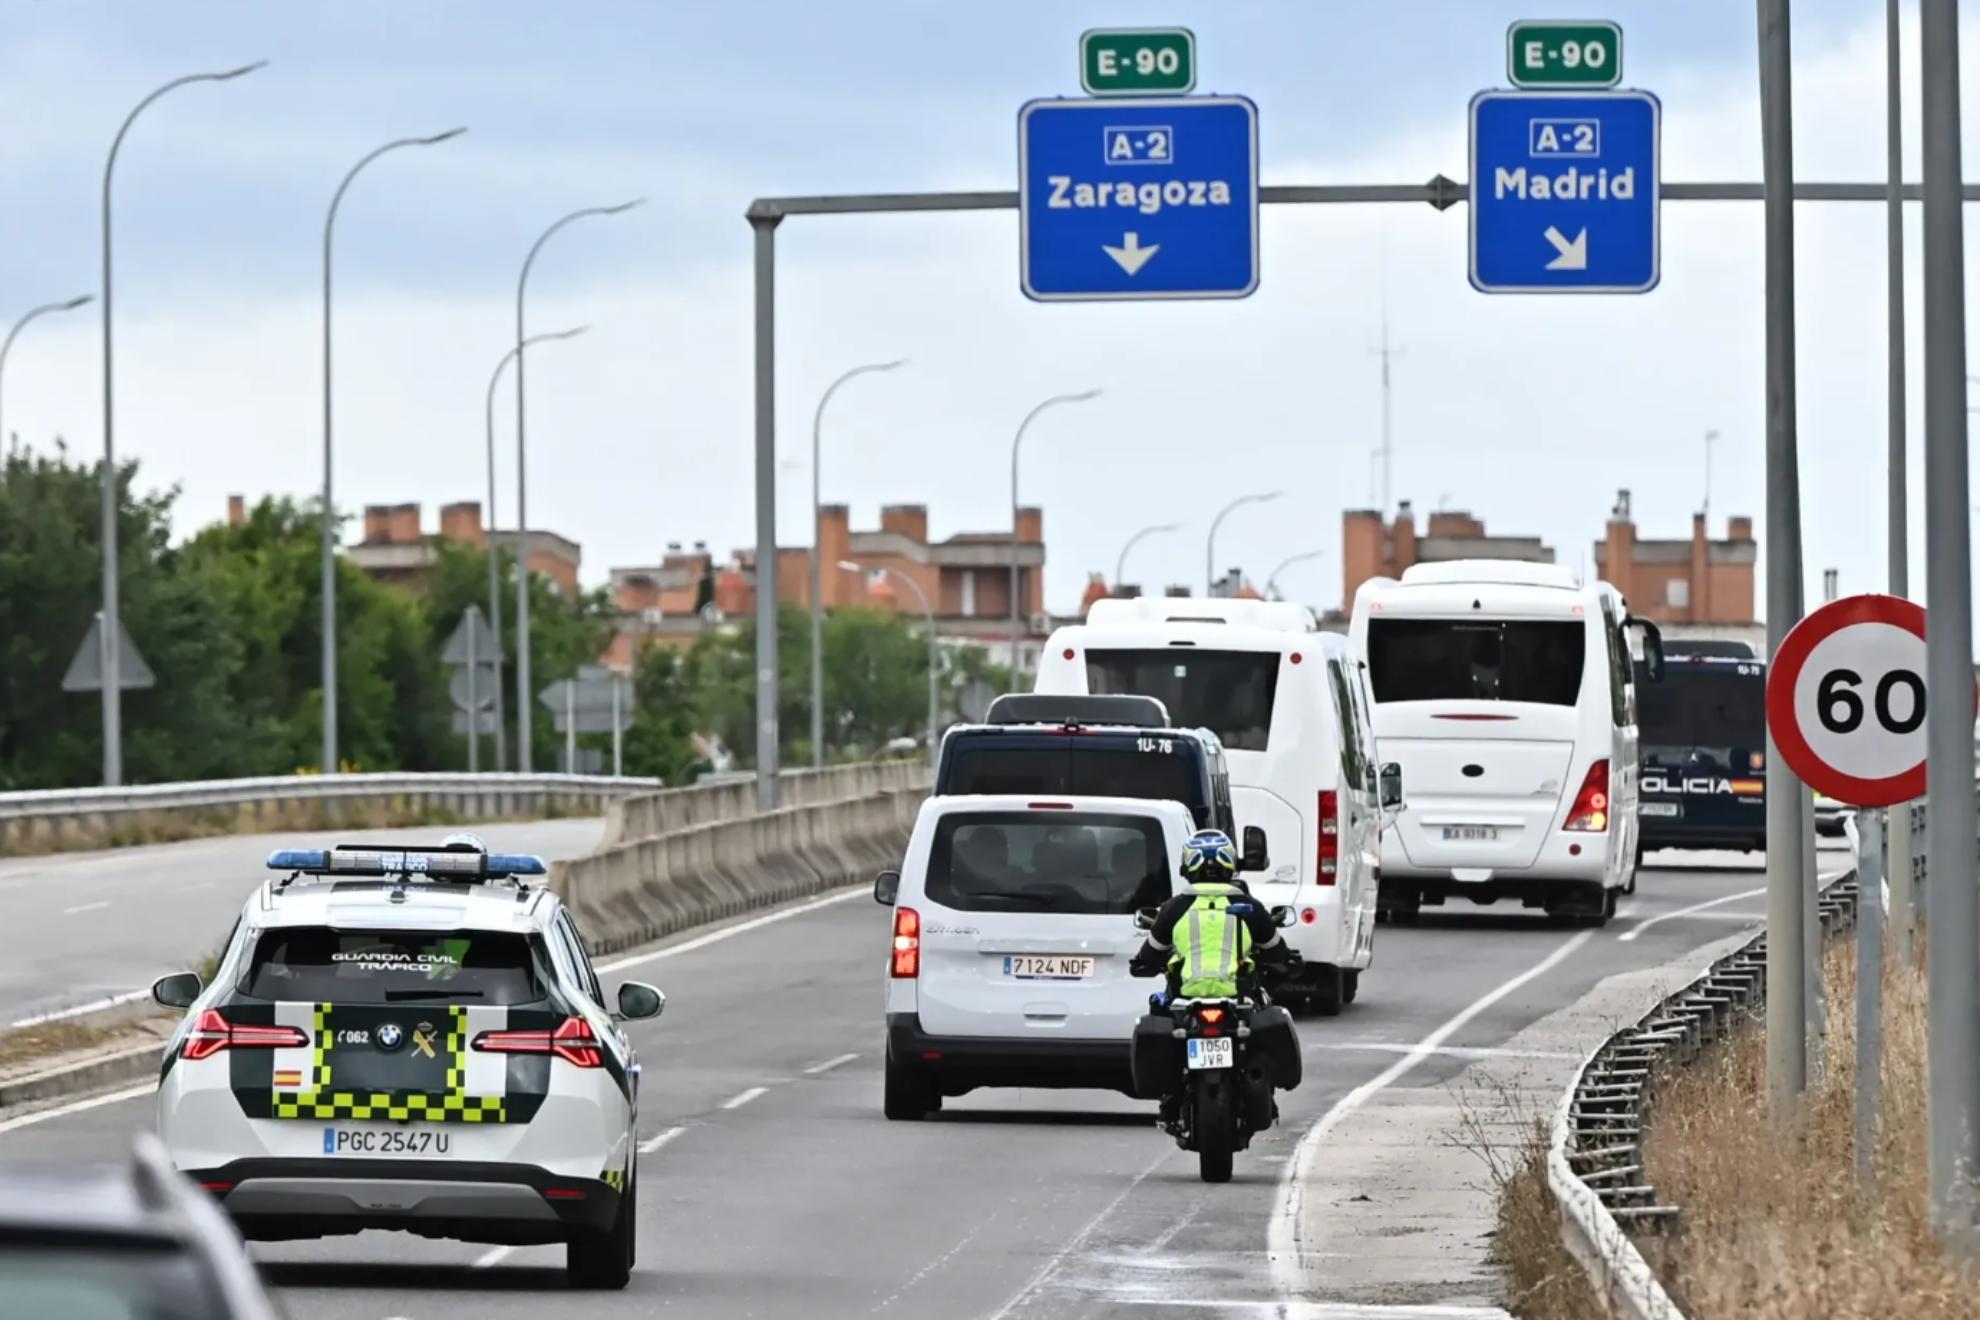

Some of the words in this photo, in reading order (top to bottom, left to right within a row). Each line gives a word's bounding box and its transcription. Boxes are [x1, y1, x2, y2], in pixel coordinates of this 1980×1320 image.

[1097, 47, 1179, 76] E-90
[1525, 40, 1605, 69] E-90
[1111, 131, 1168, 159] A-2
[1536, 124, 1594, 151] A-2
[1048, 175, 1231, 215] Zaragoza
[1495, 166, 1635, 200] Madrid
[1817, 668, 1928, 735] 60
[1640, 776, 1734, 795] OLICIA
[331, 953, 412, 962] GUARDIA
[417, 954, 458, 965] CIVIL
[1014, 958, 1054, 974] 7124
[1060, 959, 1090, 975] NDF
[346, 1030, 369, 1044] 062
[1200, 1039, 1230, 1053] 1050
[1200, 1053, 1224, 1067] JVR
[337, 1131, 376, 1152] PGC
[380, 1131, 432, 1153] 2547
[435, 1132, 449, 1153] U
